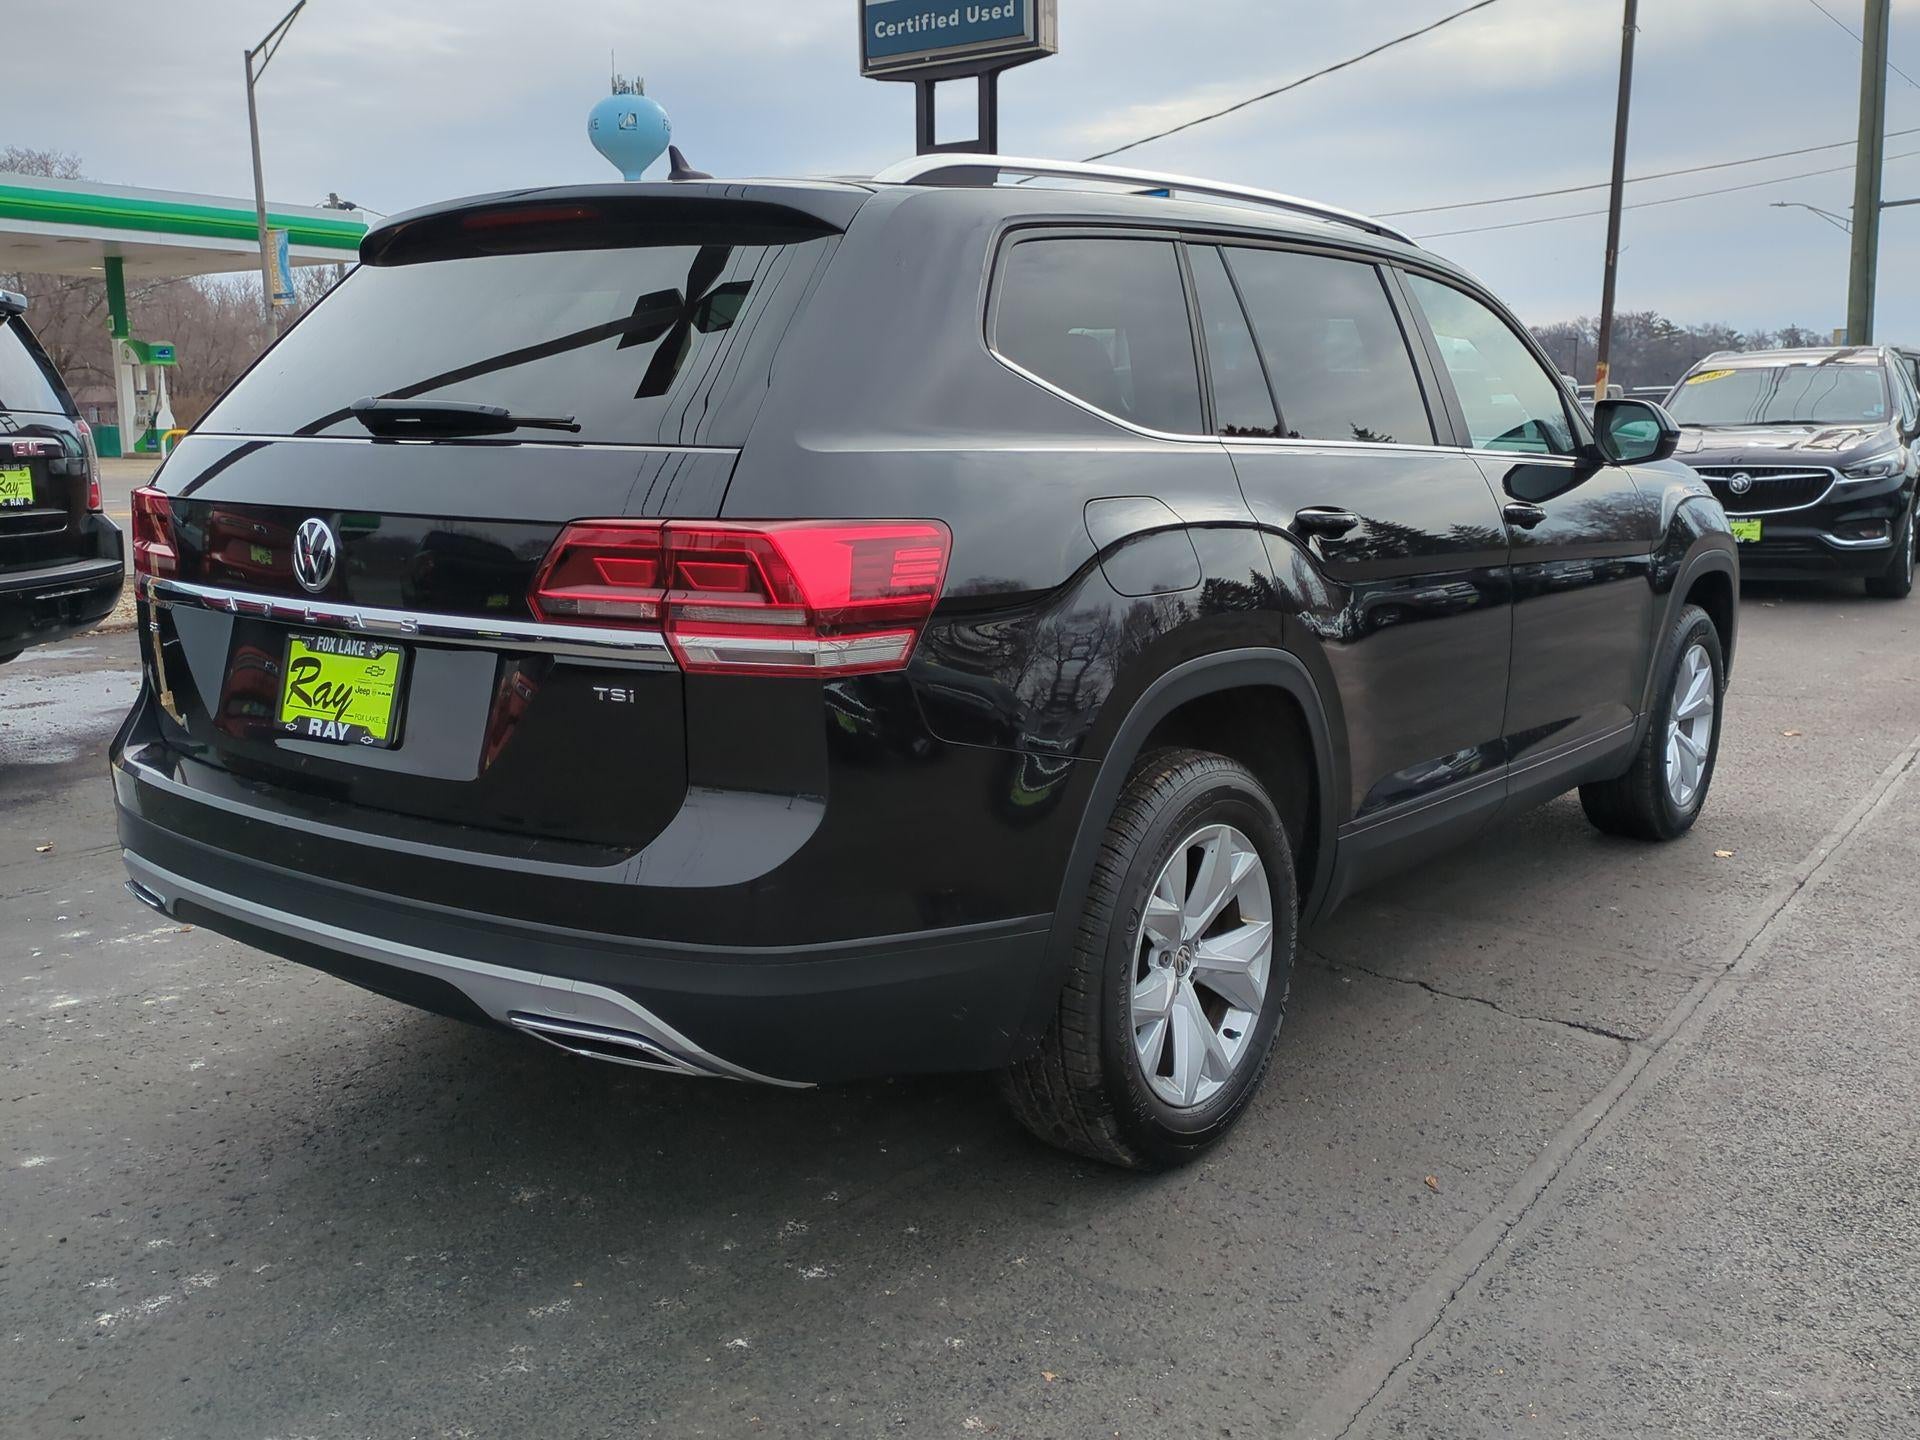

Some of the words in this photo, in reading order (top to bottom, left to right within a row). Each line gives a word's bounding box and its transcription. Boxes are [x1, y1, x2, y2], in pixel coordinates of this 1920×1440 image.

[874, 9, 959, 38] Certified
[966, 1, 1015, 23] Used
[10, 498, 24, 507] RAY
[225, 596, 419, 634] ATLAS
[316, 635, 337, 653] FOX
[338, 638, 366, 656] LAKE
[286, 657, 353, 721] Ray
[354, 685, 371, 696] Jeep
[354, 713, 364, 721] FOX
[307, 717, 350, 741] RAY
